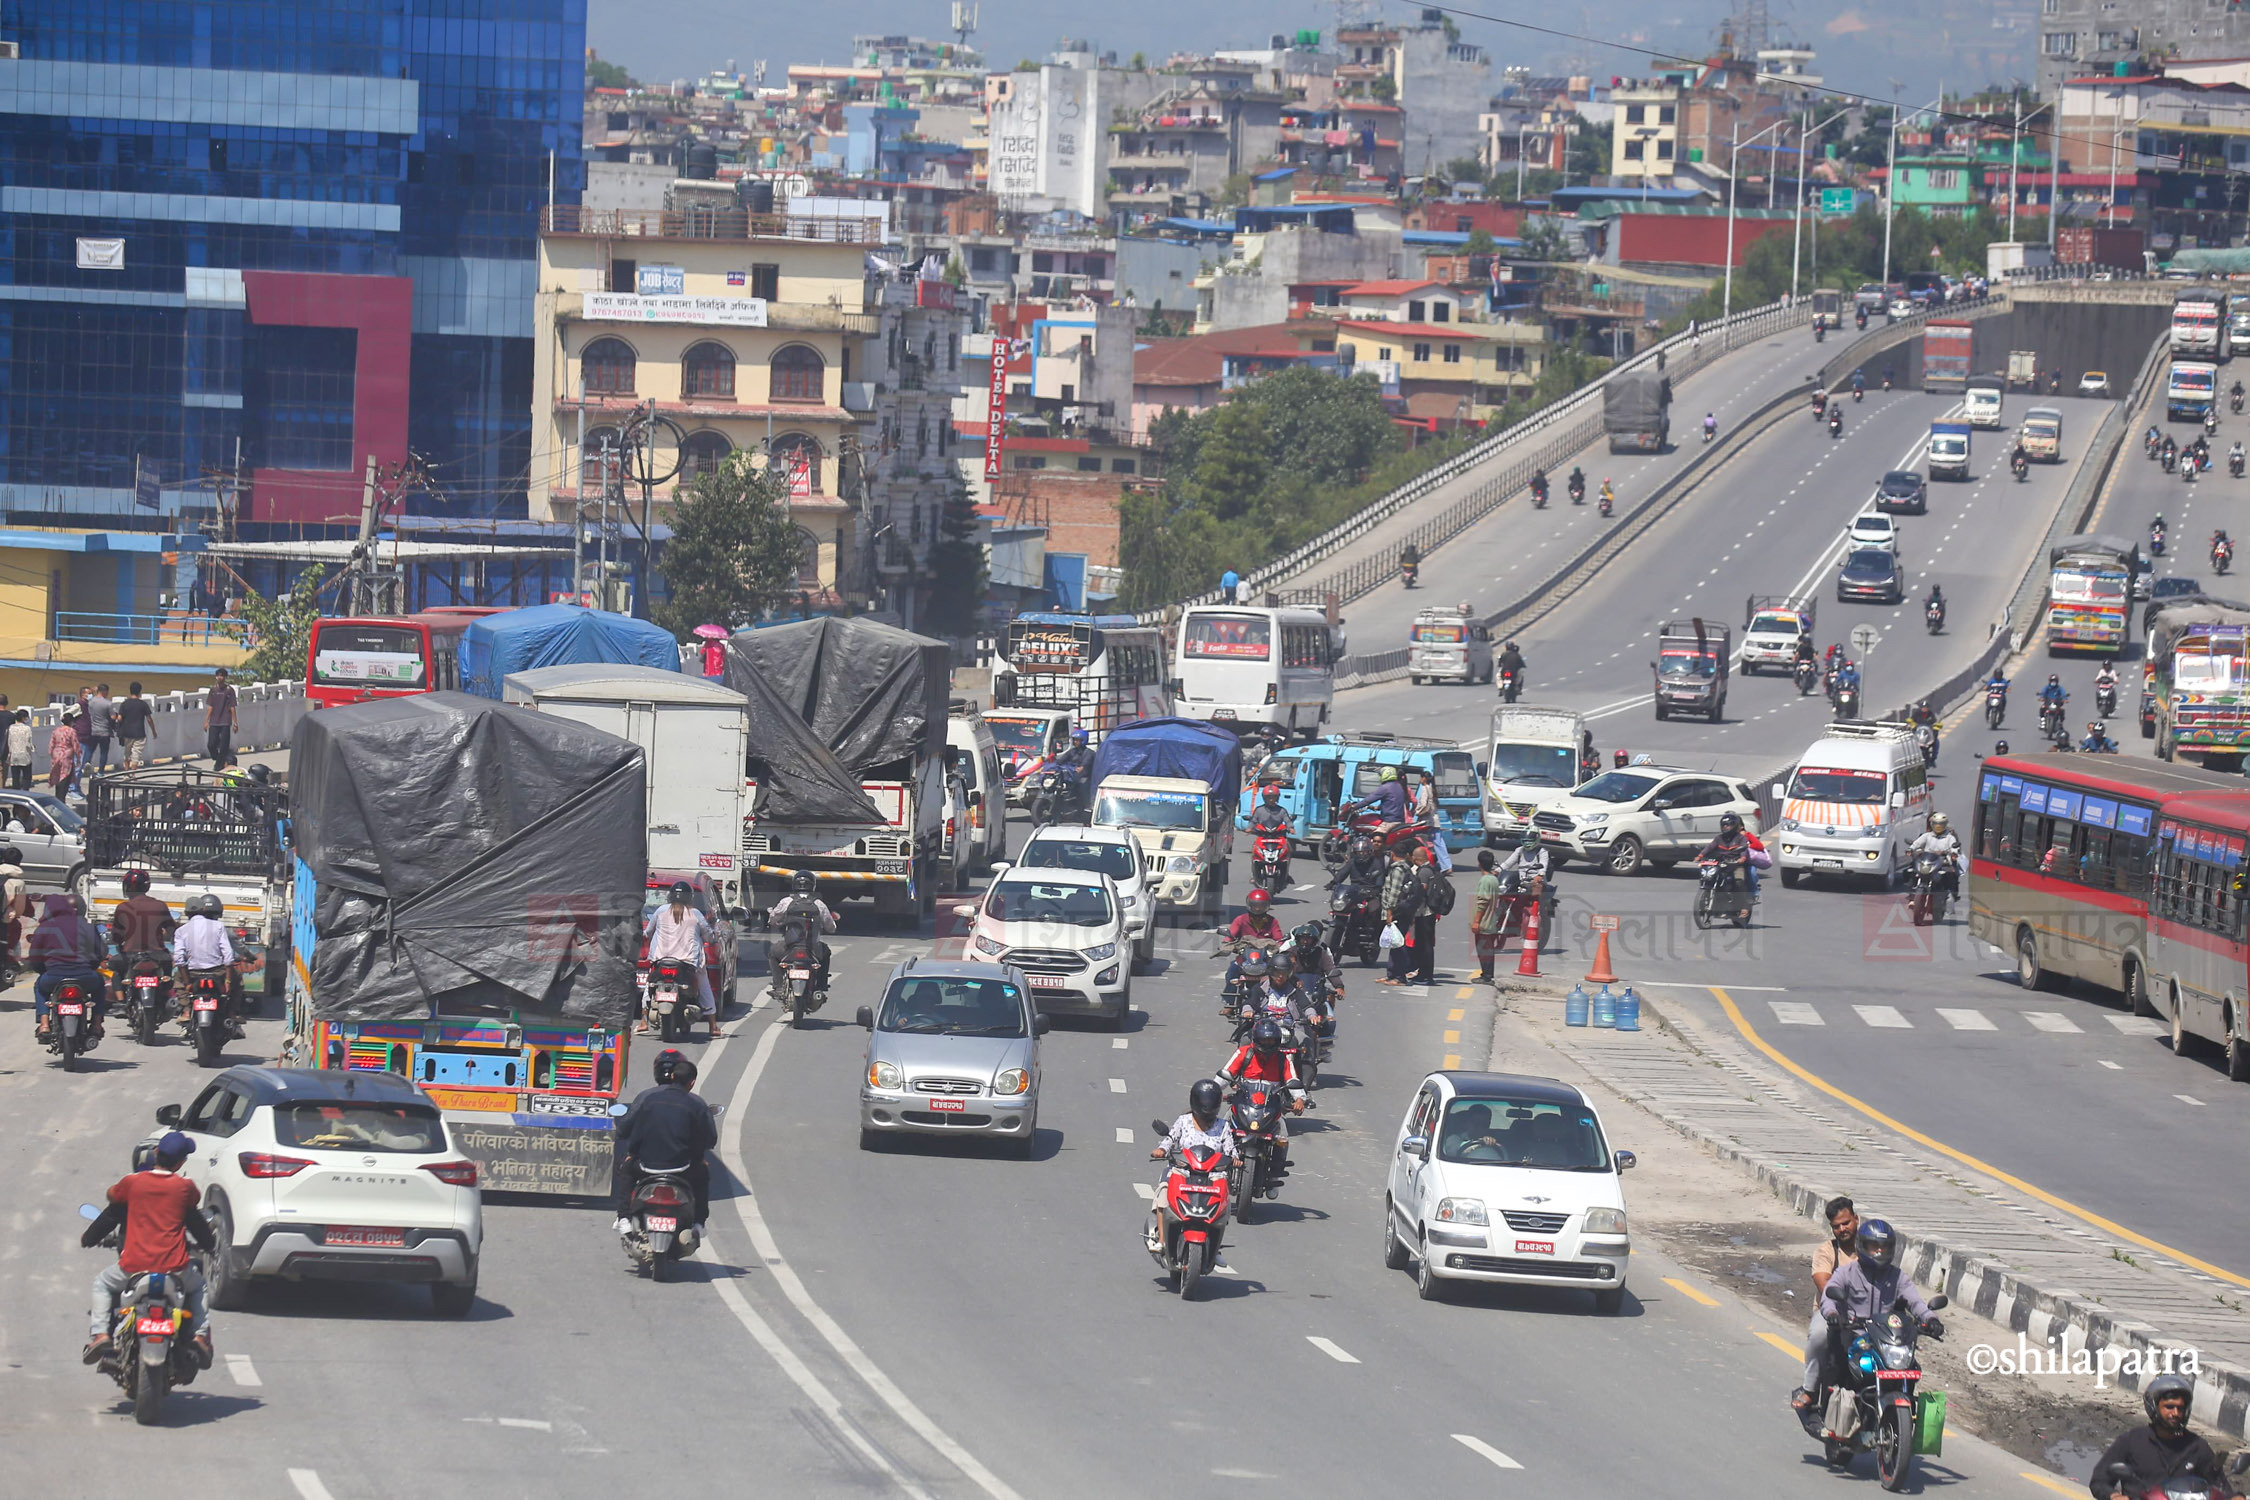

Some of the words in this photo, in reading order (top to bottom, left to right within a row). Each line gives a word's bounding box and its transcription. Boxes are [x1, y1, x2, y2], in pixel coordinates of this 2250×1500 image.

[641, 272, 662, 287] JOB
[992, 342, 1005, 407] HOTEL
[987, 411, 1001, 474] DELTA
[463, 1130, 529, 1152] परिवारको
[531, 1134, 577, 1152] भविष्य
[331, 1176, 407, 1184] MAGNITE
[540, 1158, 588, 1182] महोदय
